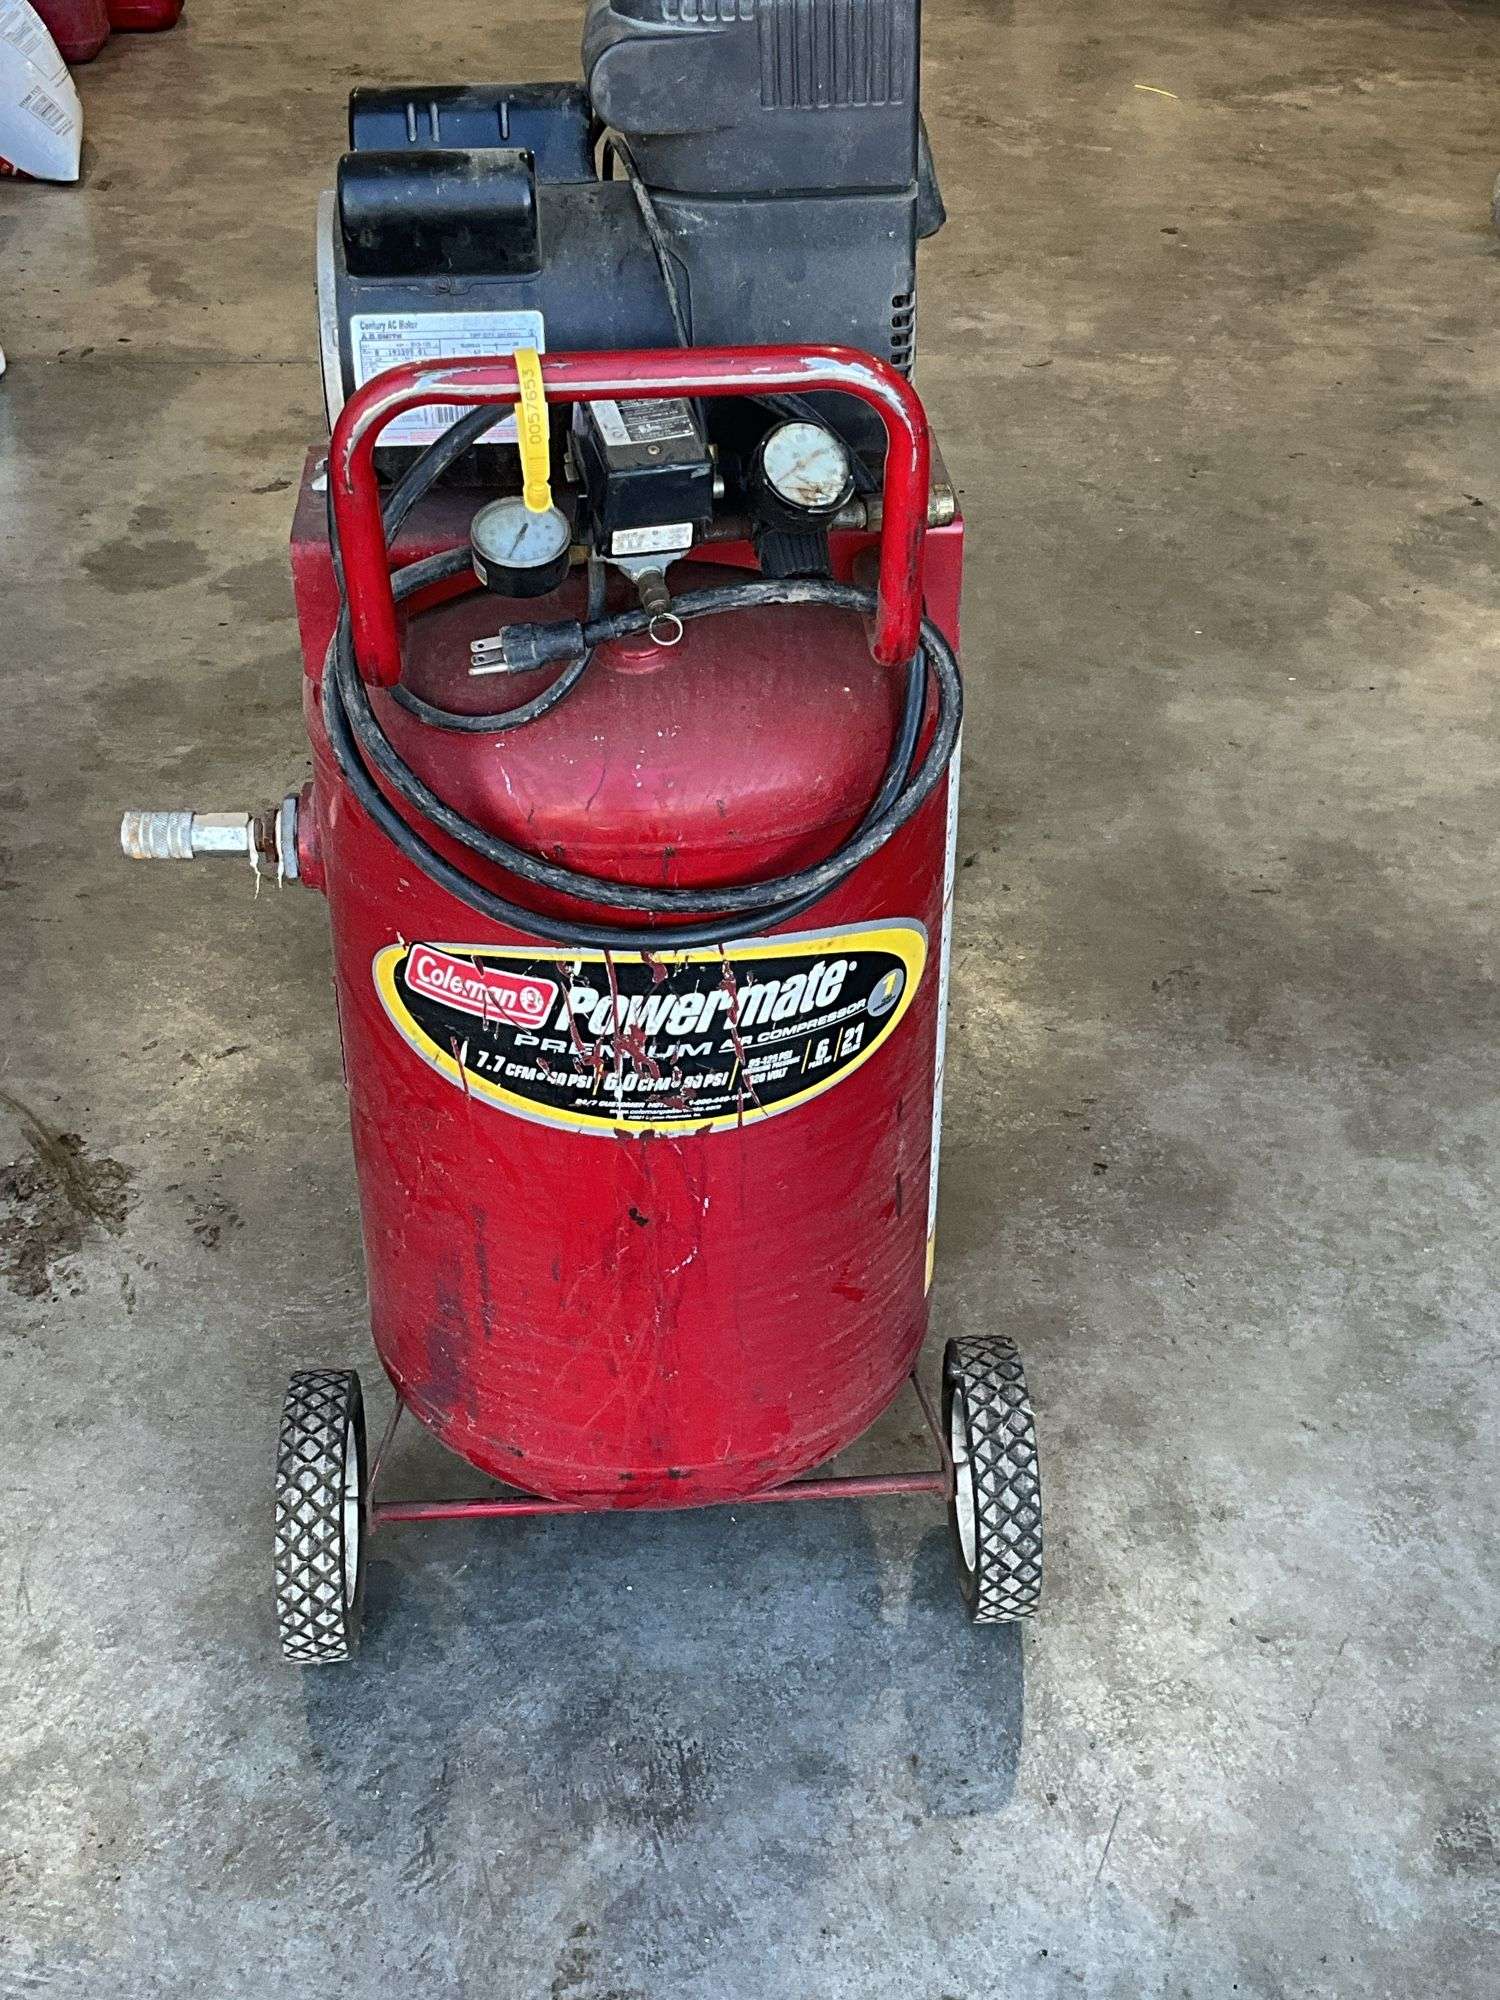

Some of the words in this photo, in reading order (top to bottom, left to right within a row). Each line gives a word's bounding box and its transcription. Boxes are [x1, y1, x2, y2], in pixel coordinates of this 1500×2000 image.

[522, 367, 543, 445] 0057653
[416, 955, 518, 1009] Coleman
[554, 959, 848, 1036] Powermate
[513, 1033, 713, 1059] PREMUM
[720, 1035, 753, 1049] AR
[757, 998, 867, 1043] COMPRESSOR
[814, 1038, 830, 1061] 6
[842, 1022, 865, 1050] 21
[476, 1050, 506, 1072] 7.7
[505, 1063, 537, 1081] CFM
[566, 1073, 593, 1089] PSI
[702, 1072, 730, 1088] PSI
